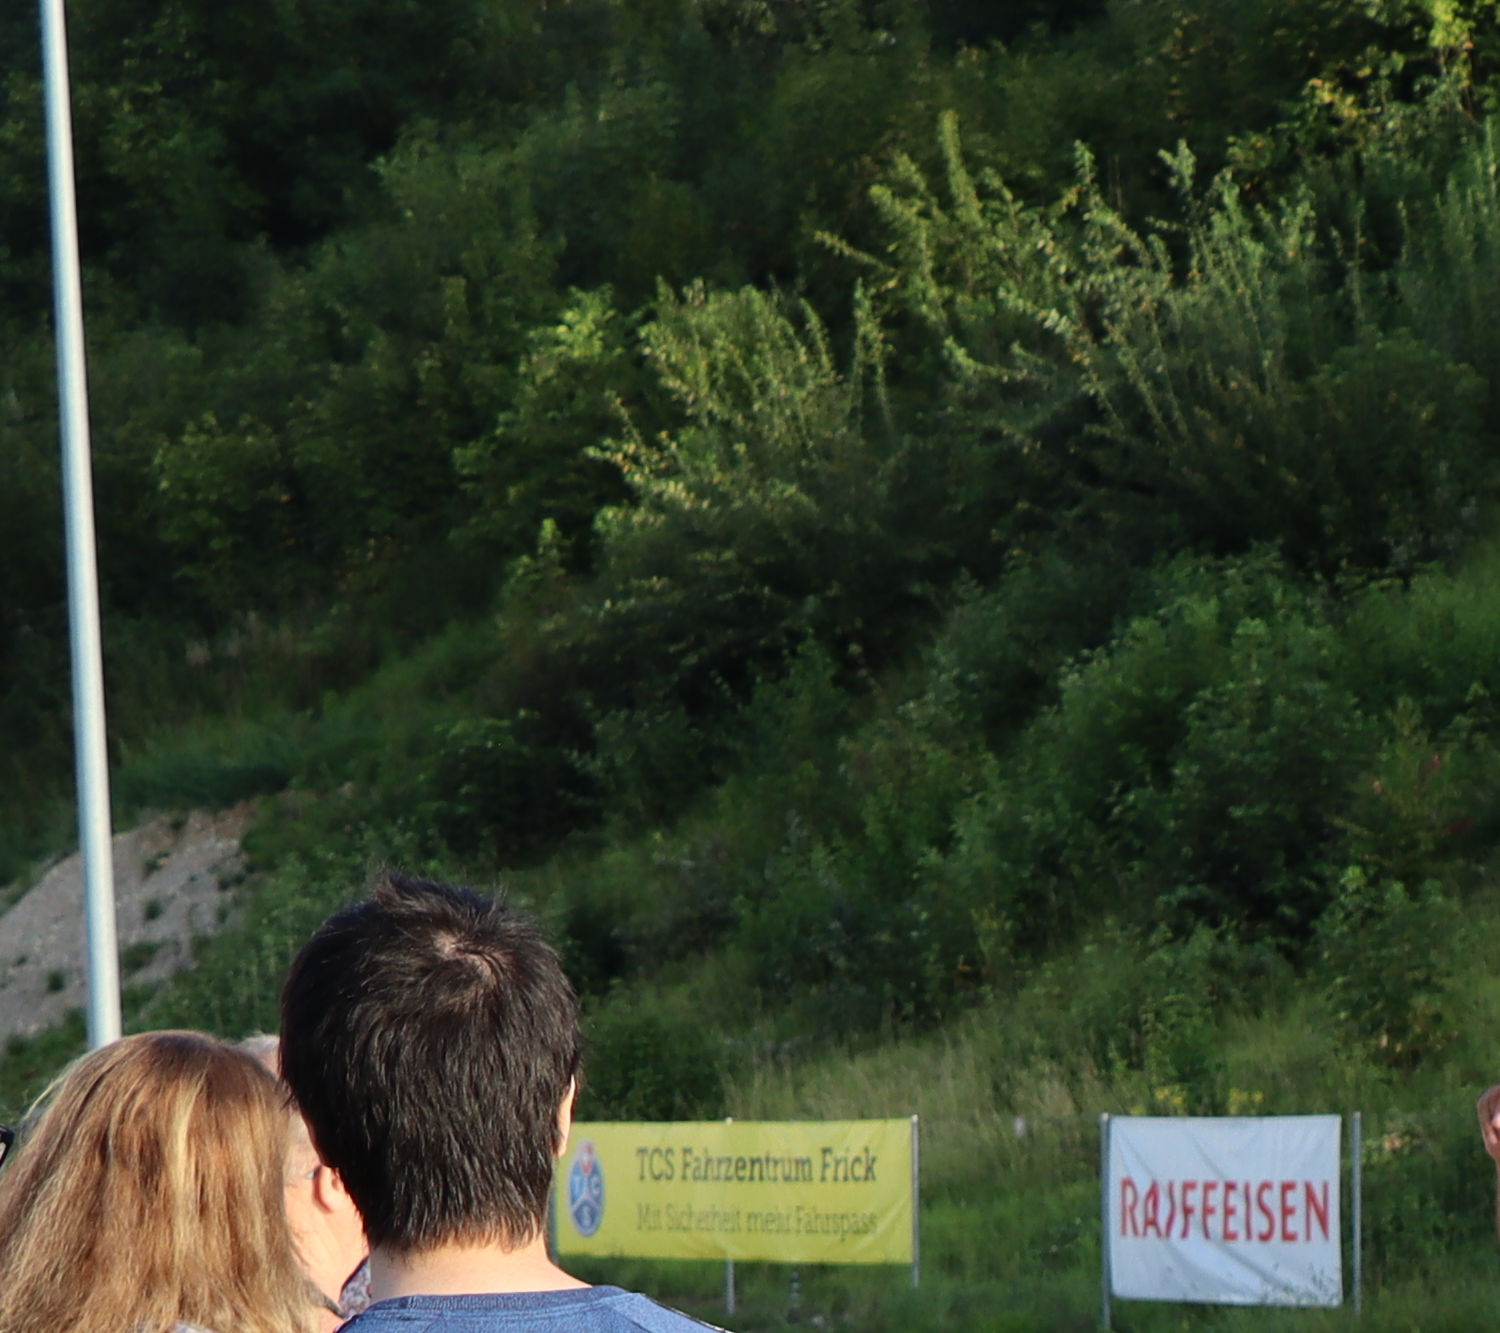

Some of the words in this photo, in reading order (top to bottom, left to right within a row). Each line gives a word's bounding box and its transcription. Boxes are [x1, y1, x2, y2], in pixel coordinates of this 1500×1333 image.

[636, 1146, 674, 1181] TCS
[681, 1146, 813, 1182] Fahrzentrum
[820, 1146, 877, 1182] Frick
[636, 1203, 662, 1231] Mit
[665, 1203, 742, 1232] Sicherheit
[794, 1205, 877, 1242] Fahrspass
[1118, 1176, 1330, 1242] RAIFFEISEN
